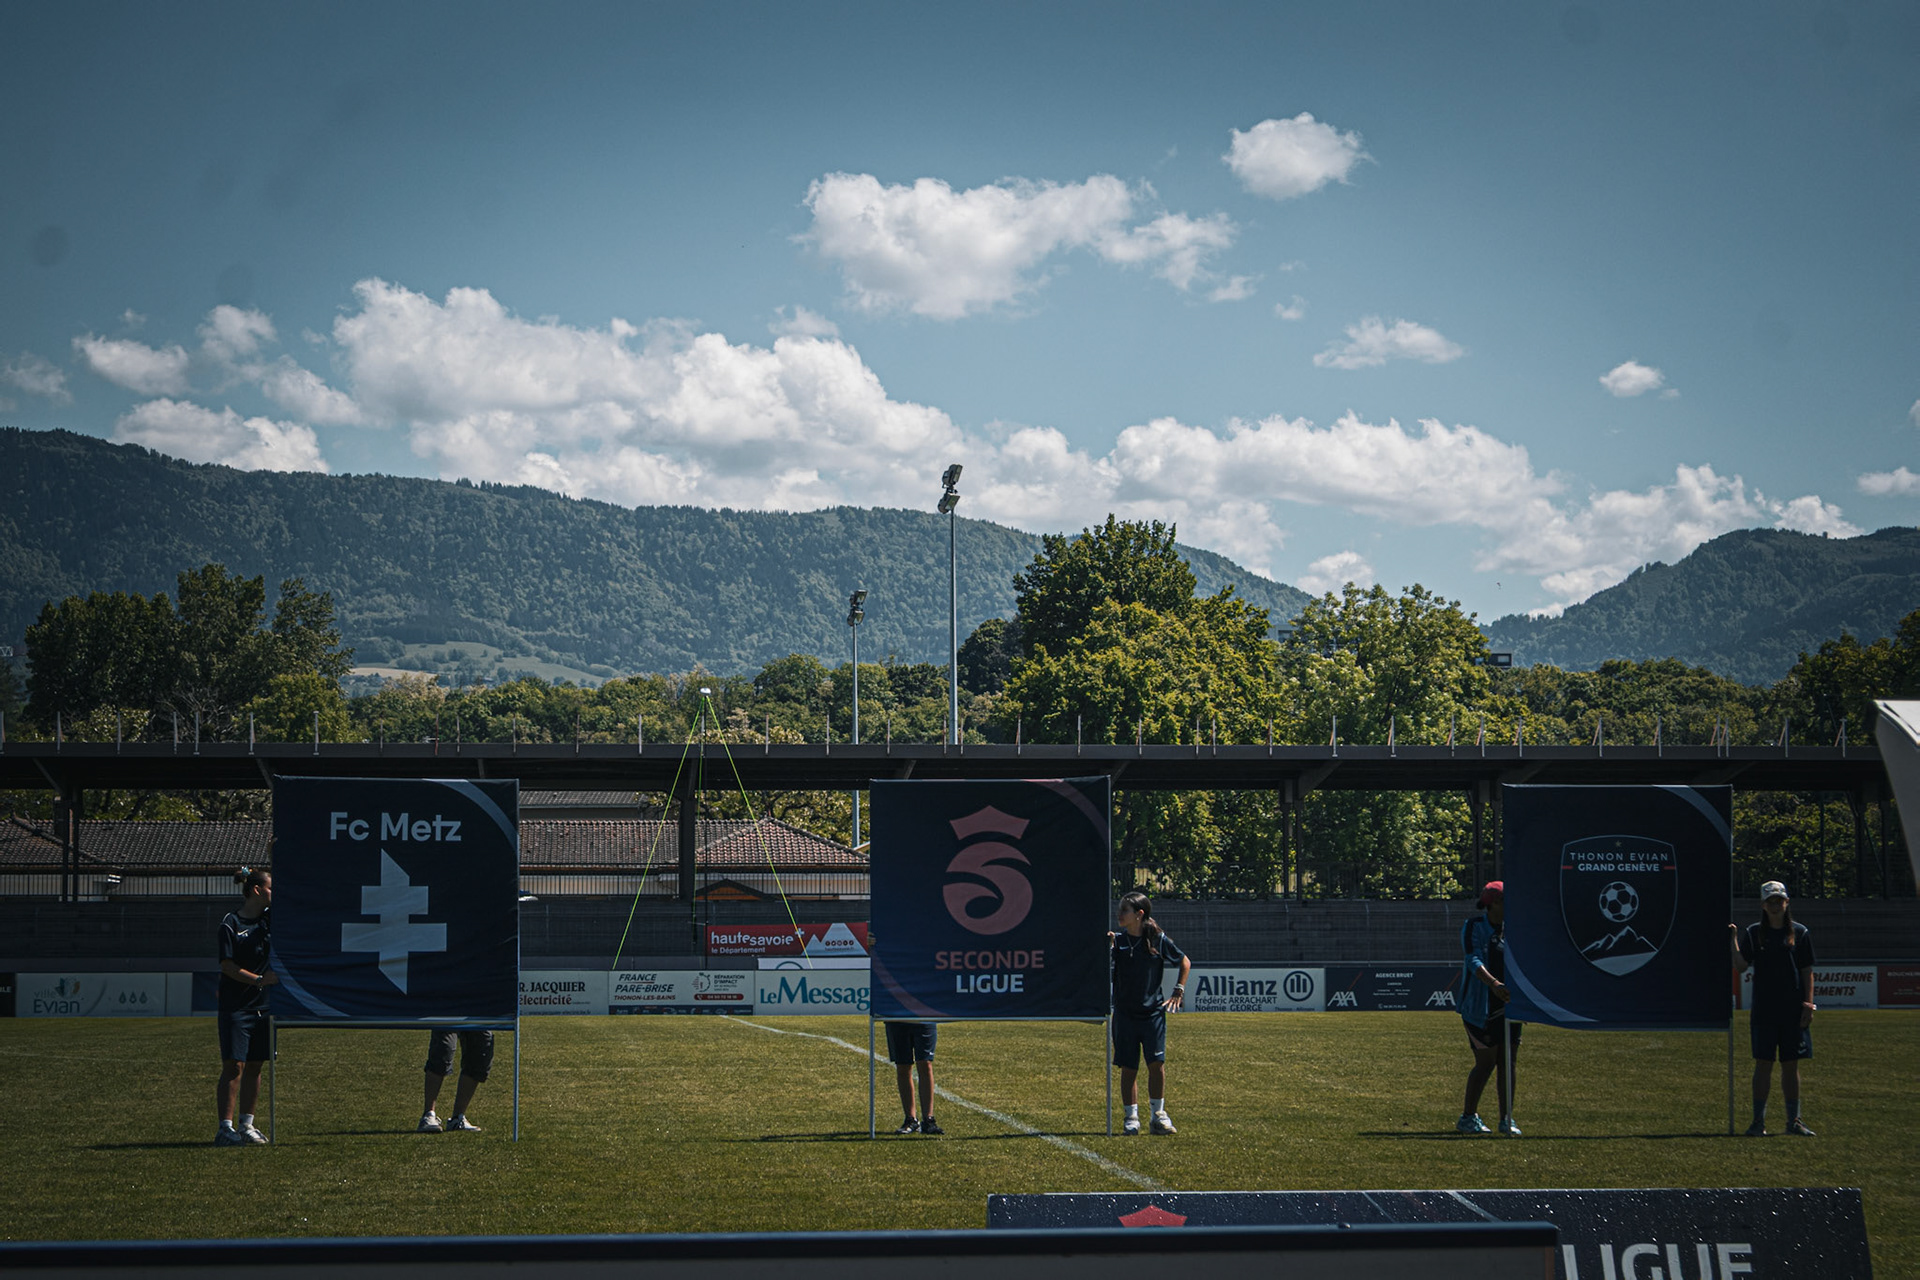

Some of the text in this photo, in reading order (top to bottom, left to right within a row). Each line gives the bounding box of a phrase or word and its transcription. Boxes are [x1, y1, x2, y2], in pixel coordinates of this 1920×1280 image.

[330, 811, 462, 842] Fc Metz
[1570, 852, 1668, 861] THONON EVIAN
[1578, 861, 1660, 872] GRAND GENÈVE
[711, 946, 766, 955] le Département
[935, 950, 1045, 969] SECONDE
[619, 973, 657, 981] FRANCE
[530, 982, 586, 994] JACQUIER
[615, 984, 674, 993] PARE-BRISE
[956, 974, 1024, 993] LIGUE
[1195, 976, 1277, 996] Allianz
[1195, 996, 1277, 1005] Frédéric ARRACHART
[1327, 991, 1358, 1006] AXA
[1425, 991, 1456, 1006] AXA
[33, 999, 80, 1014] Evian
[1195, 1003, 1262, 1012] Noémie GEORGE
